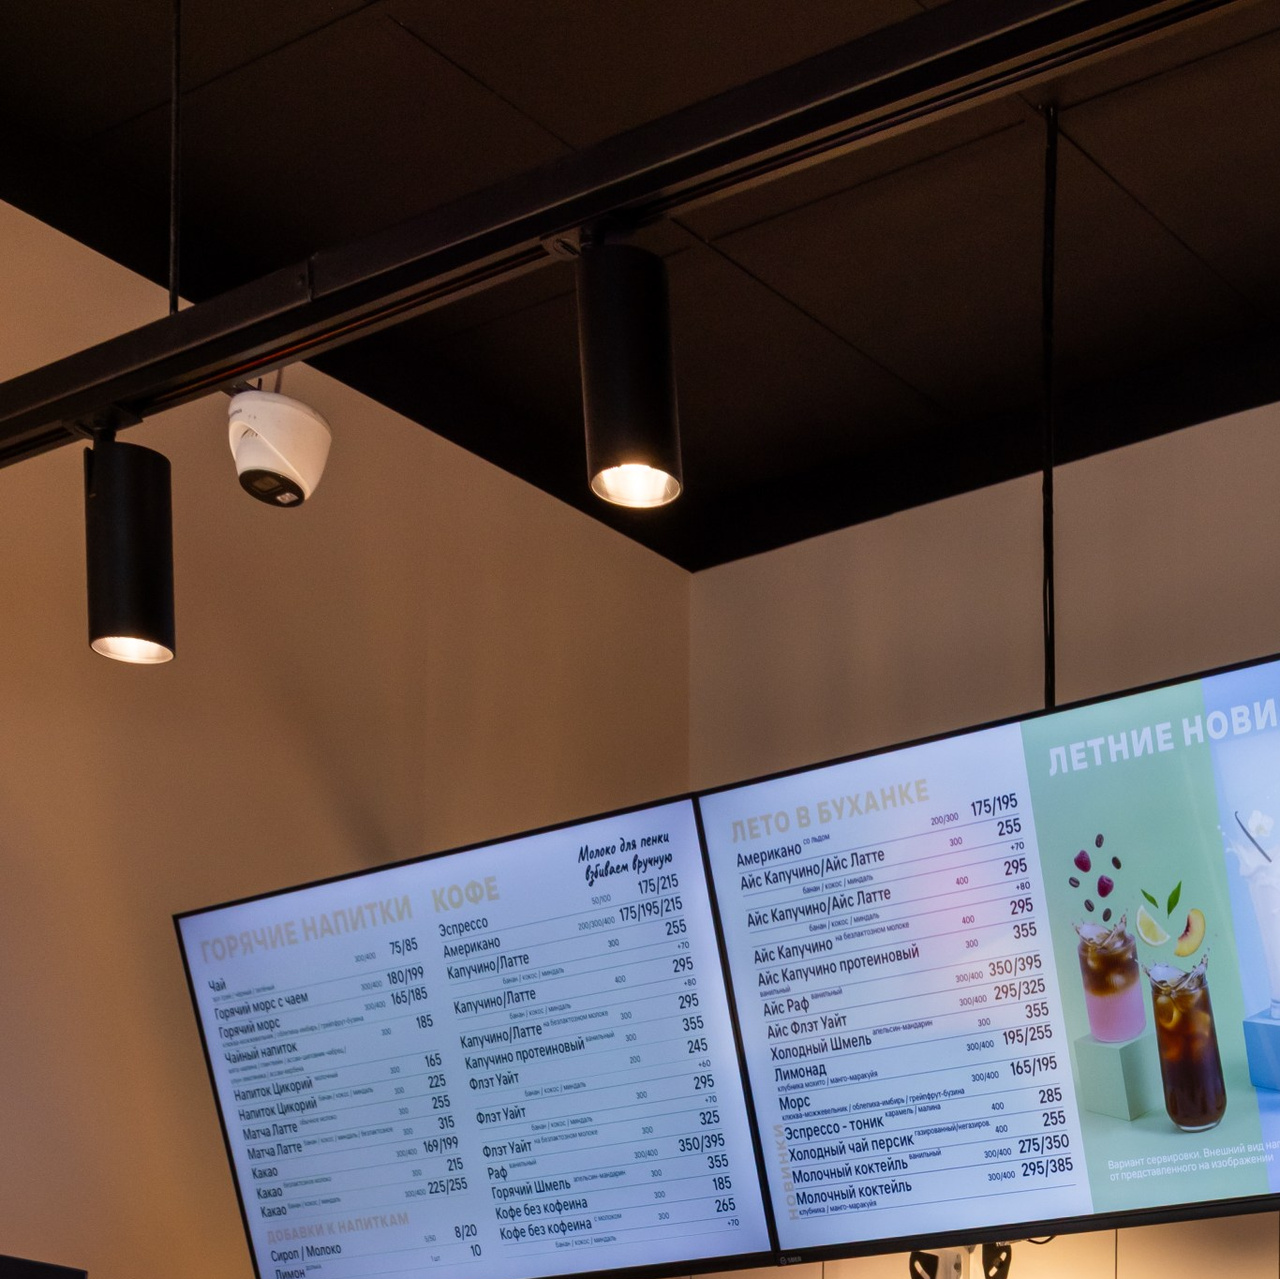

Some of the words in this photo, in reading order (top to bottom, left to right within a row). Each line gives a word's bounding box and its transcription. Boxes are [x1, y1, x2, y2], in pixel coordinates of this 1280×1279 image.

[1049, 719, 1175, 776] ЛЕТНИЕ
[731, 813, 791, 844] ЛЕТО
[797, 807, 812, 828] В
[819, 779, 930, 824] БУХАНКЕ
[736, 842, 802, 869] Американо
[931, 813, 959, 827] 200/300
[970, 793, 1018, 817] 175/195
[578, 844, 616, 864] Молоко
[619, 836, 637, 852] для
[640, 832, 670, 848] пенки
[585, 861, 628, 887] взбиваем
[632, 852, 673, 871] вручную
[740, 872, 762, 891] Айс
[764, 857, 848, 888] Капучино/Айс
[850, 849, 885, 868] Латте
[950, 837, 963, 847] 300
[997, 818, 1022, 837] 255
[432, 876, 500, 913] КОФЕ
[438, 917, 488, 937] Эспрессо
[638, 874, 679, 894] 175/215
[200, 922, 298, 965] ГОРЯЧИЕ
[301, 895, 413, 941] НАПИТКИ
[443, 935, 501, 958] Американо
[578, 916, 616, 931] 200/300/400
[619, 896, 683, 922] 175/195/215
[446, 952, 530, 979] Капучино/Латте
[608, 938, 620, 948] 300
[665, 919, 687, 936] 255
[774, 1061, 827, 1082] Лимонад
[966, 1040, 995, 1052] 300/400
[1002, 1024, 1053, 1046] 195/255
[1108, 1157, 1145, 1170] Вариант
[1203, 1143, 1245, 1158] Внешний
[1247, 1142, 1265, 1153] вид
